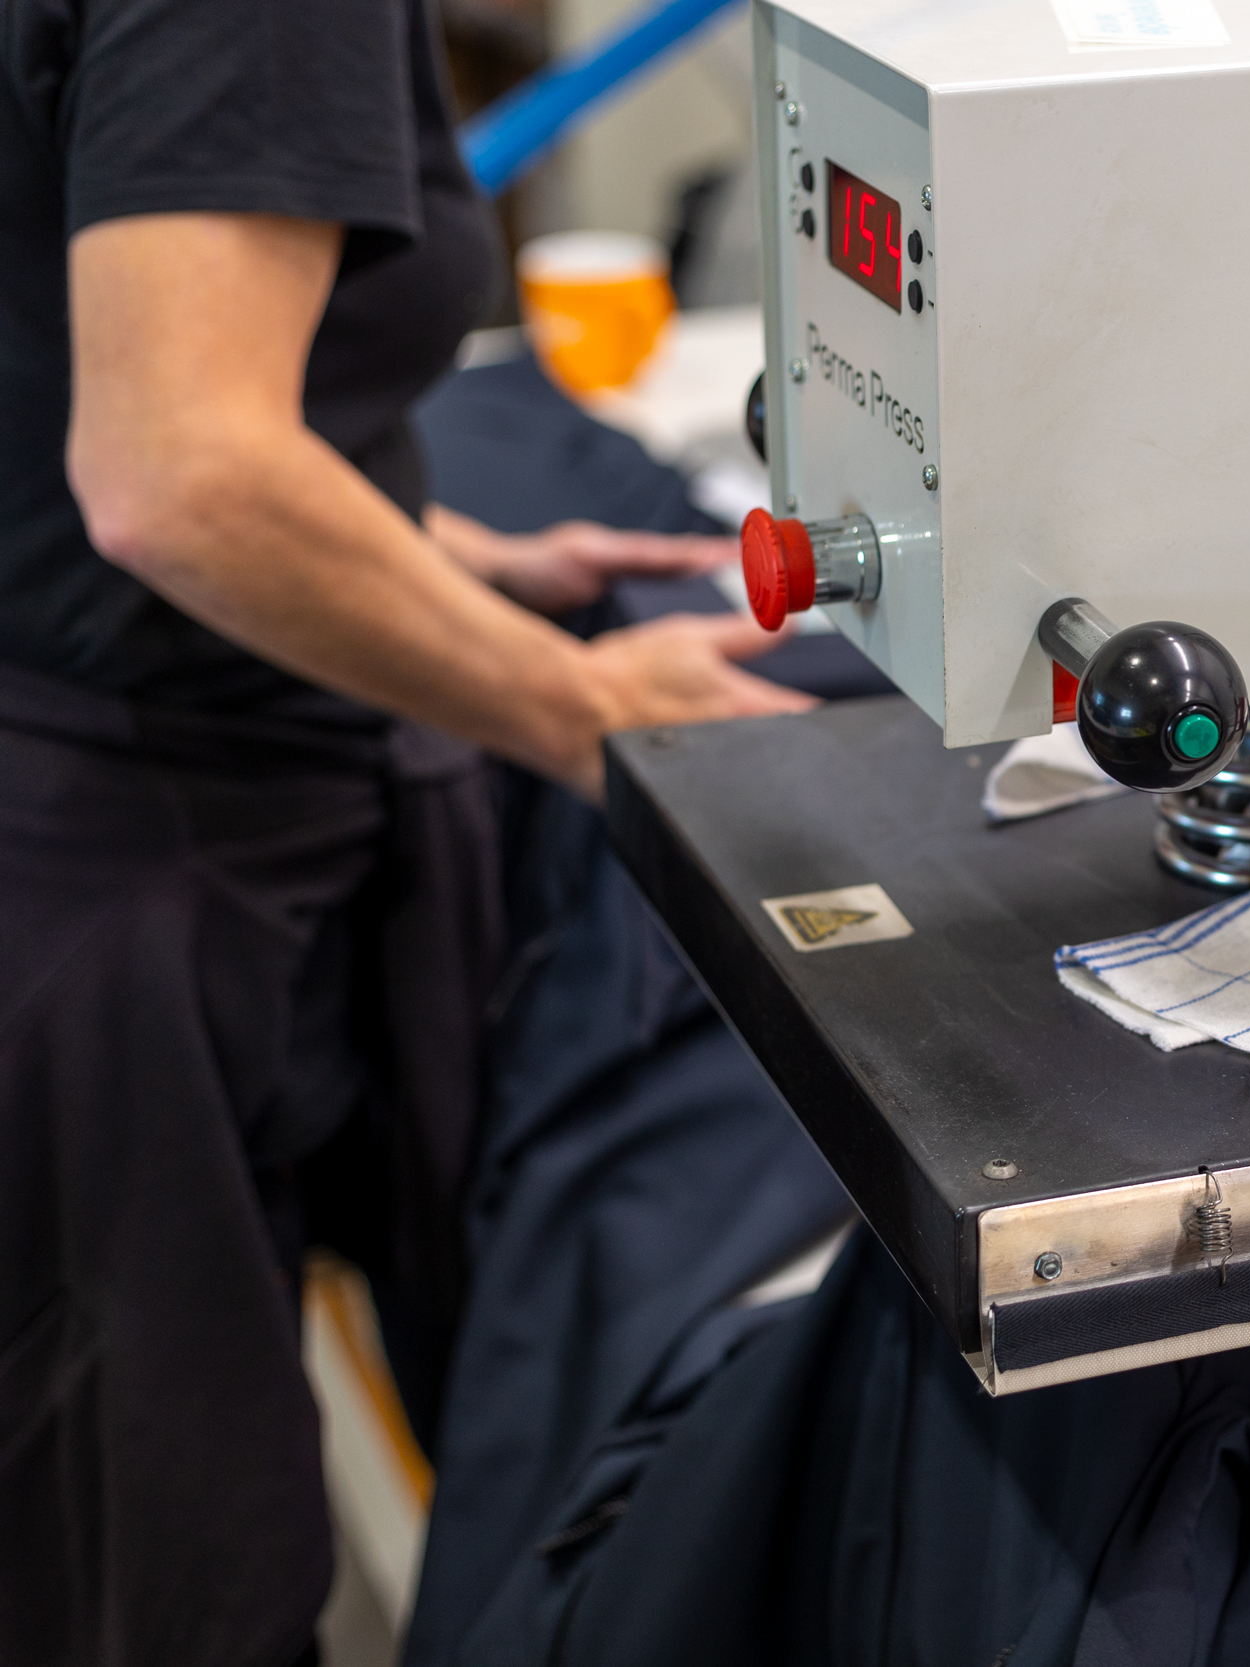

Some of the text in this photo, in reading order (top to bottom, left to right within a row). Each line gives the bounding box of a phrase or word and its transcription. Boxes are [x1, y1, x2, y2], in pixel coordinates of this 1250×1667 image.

[843, 186, 902, 293] 154
[807, 322, 925, 454] Perma Press
